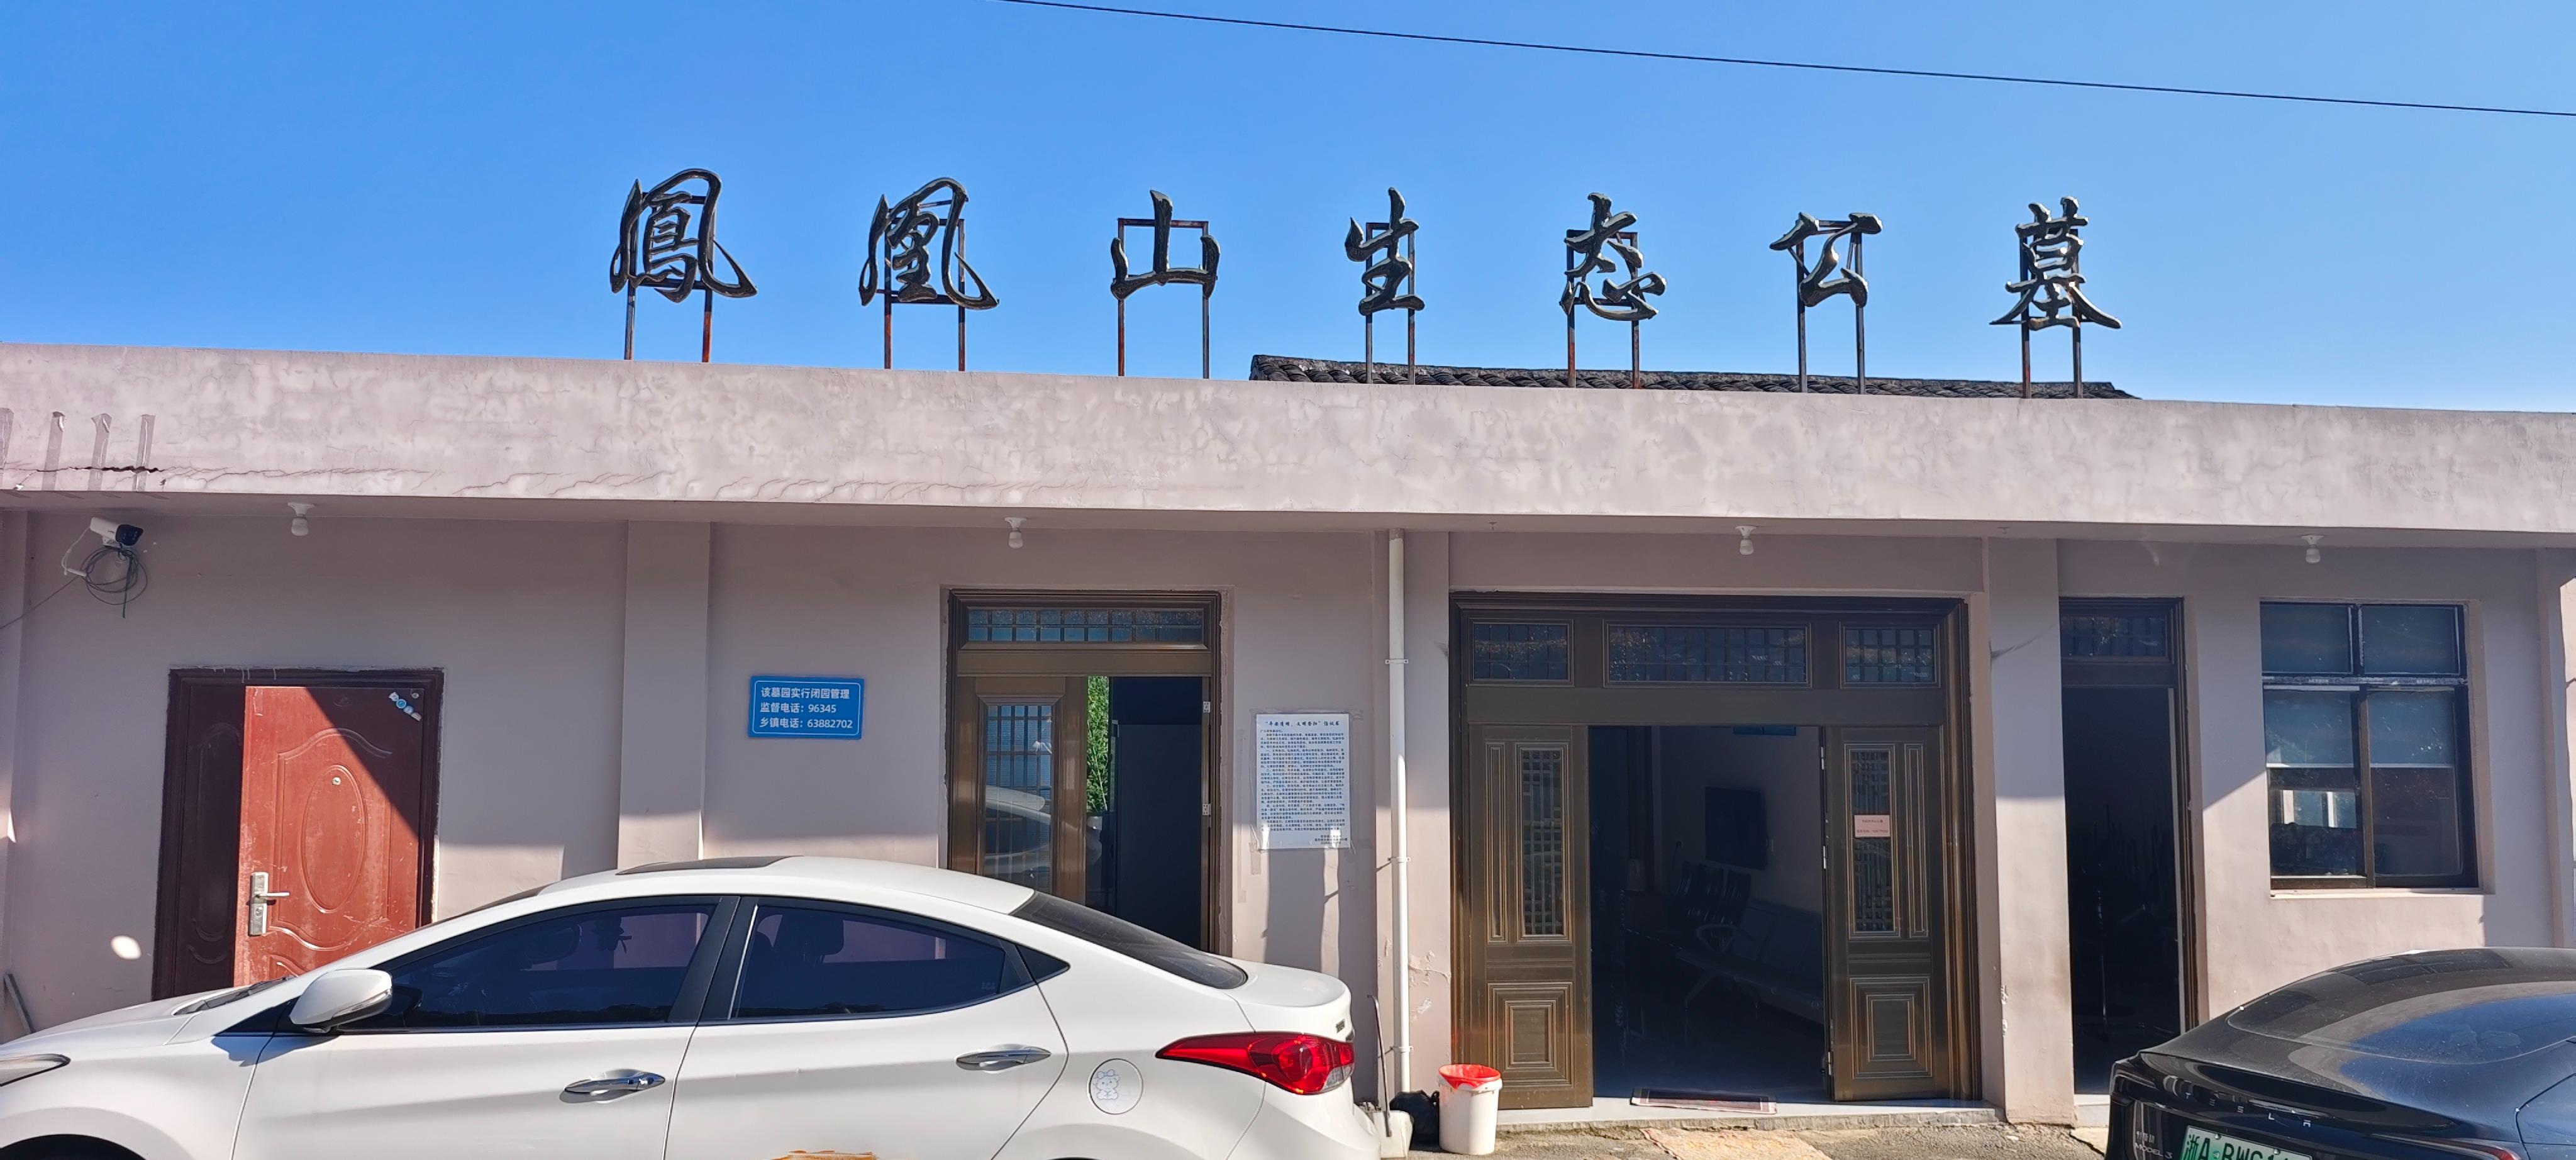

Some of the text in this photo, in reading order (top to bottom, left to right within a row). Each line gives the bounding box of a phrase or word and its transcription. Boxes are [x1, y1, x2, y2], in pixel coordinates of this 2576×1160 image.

[761, 687, 850, 699] 该墓园实行闭园管理
[2134, 1142, 2163, 1157] MODEL
